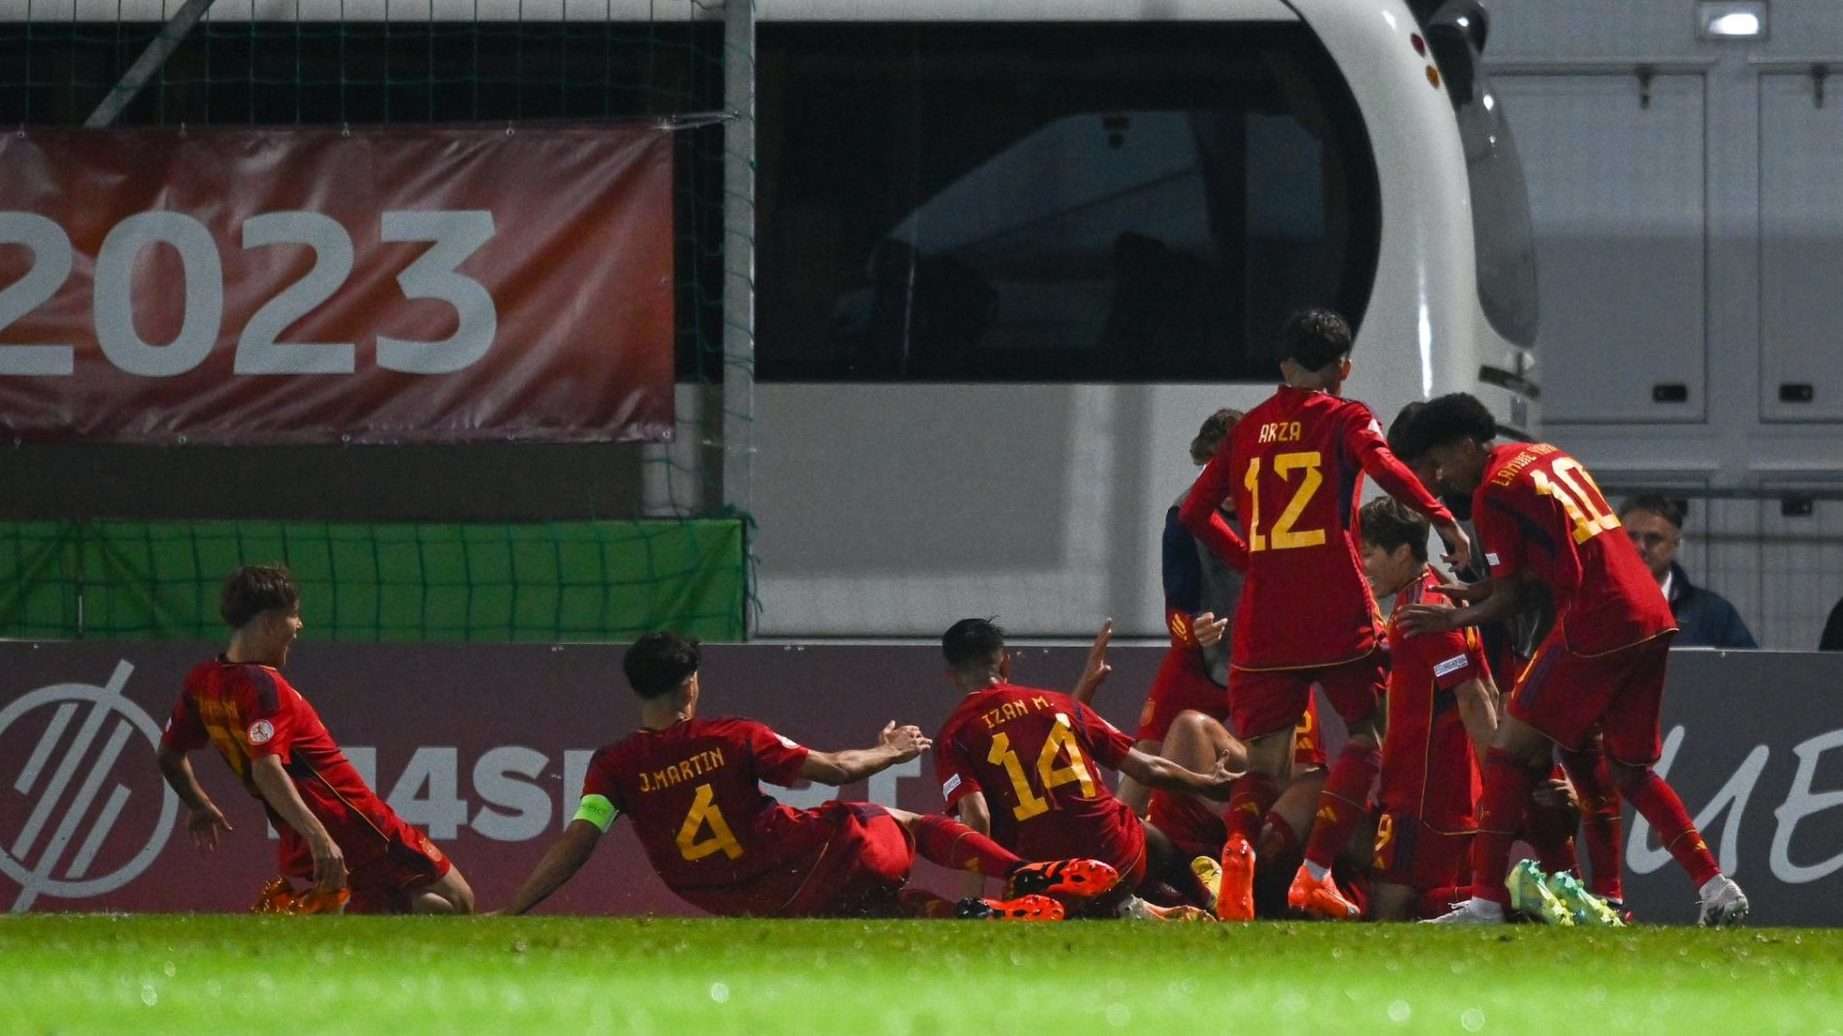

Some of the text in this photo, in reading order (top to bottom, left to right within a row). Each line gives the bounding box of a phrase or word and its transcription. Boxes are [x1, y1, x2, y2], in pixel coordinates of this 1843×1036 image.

[0, 211, 497, 377] 2023
[1258, 421, 1302, 443] ARZA
[1244, 451, 1326, 552] 12
[1529, 456, 1622, 545] 10
[981, 698, 1029, 729] IZAN
[639, 747, 725, 792] J.MARTIN
[987, 712, 1096, 821] 14
[676, 783, 744, 861] 4
